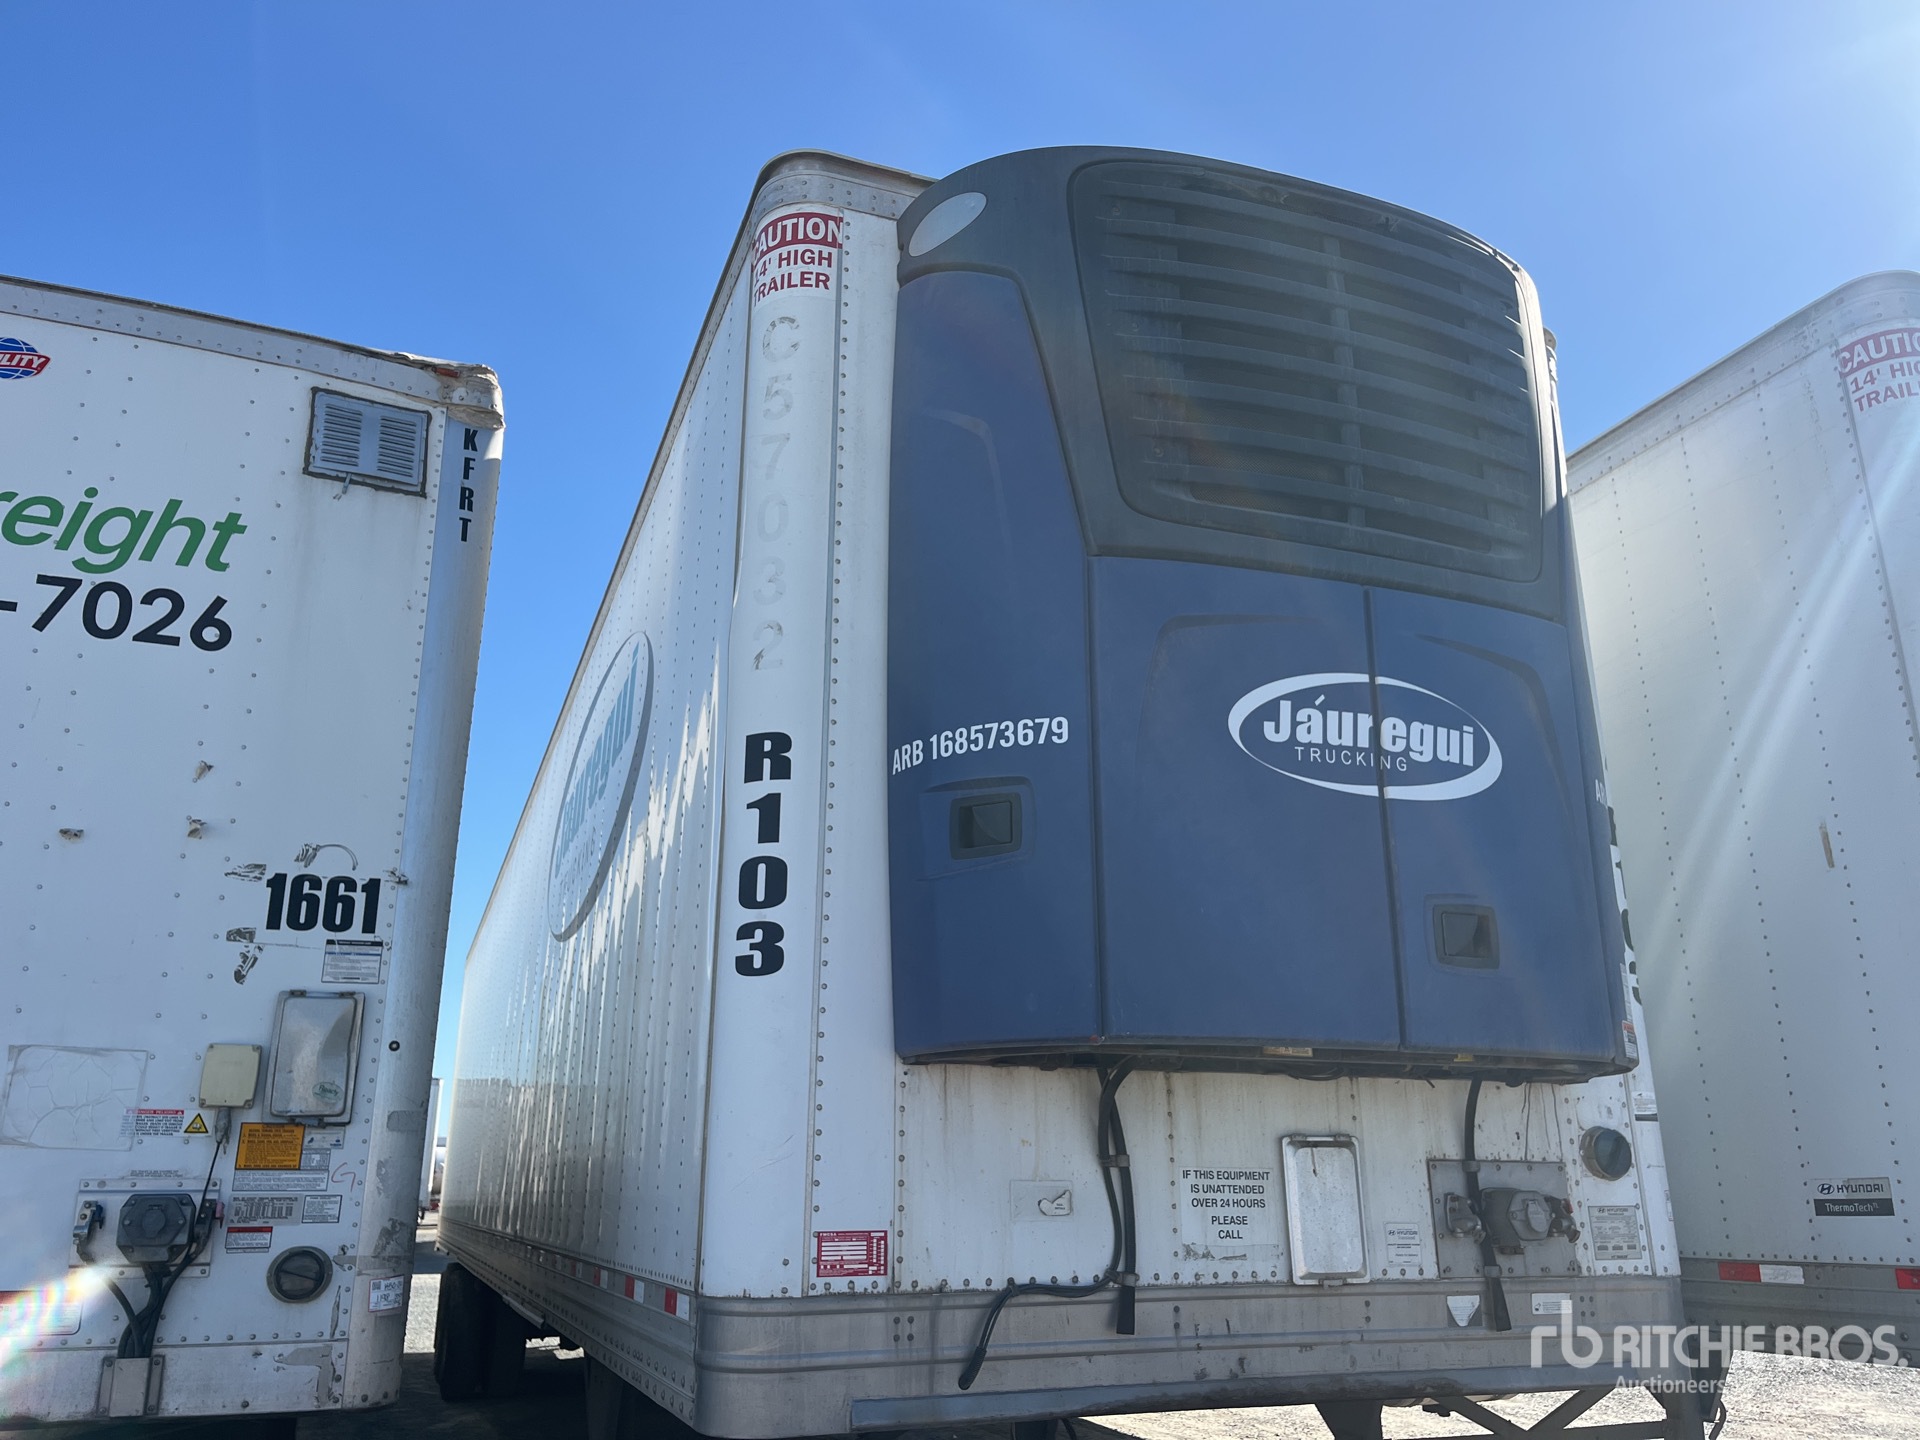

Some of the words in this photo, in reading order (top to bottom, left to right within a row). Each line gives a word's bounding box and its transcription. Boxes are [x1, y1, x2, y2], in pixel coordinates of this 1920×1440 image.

[777, 248, 833, 269] HIGH
[754, 271, 831, 308] TRAILER
[1854, 381, 1920, 412] TRAIL
[459, 427, 479, 543] KFRT
[1263, 694, 1474, 767] Jáuregui
[892, 739, 923, 775] ARB
[929, 716, 1069, 760] 168573679
[1294, 746, 1408, 772] TRUCKING
[735, 731, 793, 977] R103
[265, 873, 381, 934] 1661
[1182, 1169, 1191, 1179] IF
[1193, 1170, 1215, 1180] THIS
[1216, 1170, 1270, 1181] EQUIPMENT
[1190, 1183, 1200, 1194] IS
[1202, 1184, 1265, 1195] UNATTENDED
[1836, 1183, 1884, 1194] HYUNDAI
[1191, 1198, 1218, 1208] OVER
[1219, 1199, 1230, 1208] 24
[1232, 1199, 1266, 1209] HOURS
[1211, 1215, 1248, 1226] PLEASE
[1218, 1230, 1243, 1240] CALL
